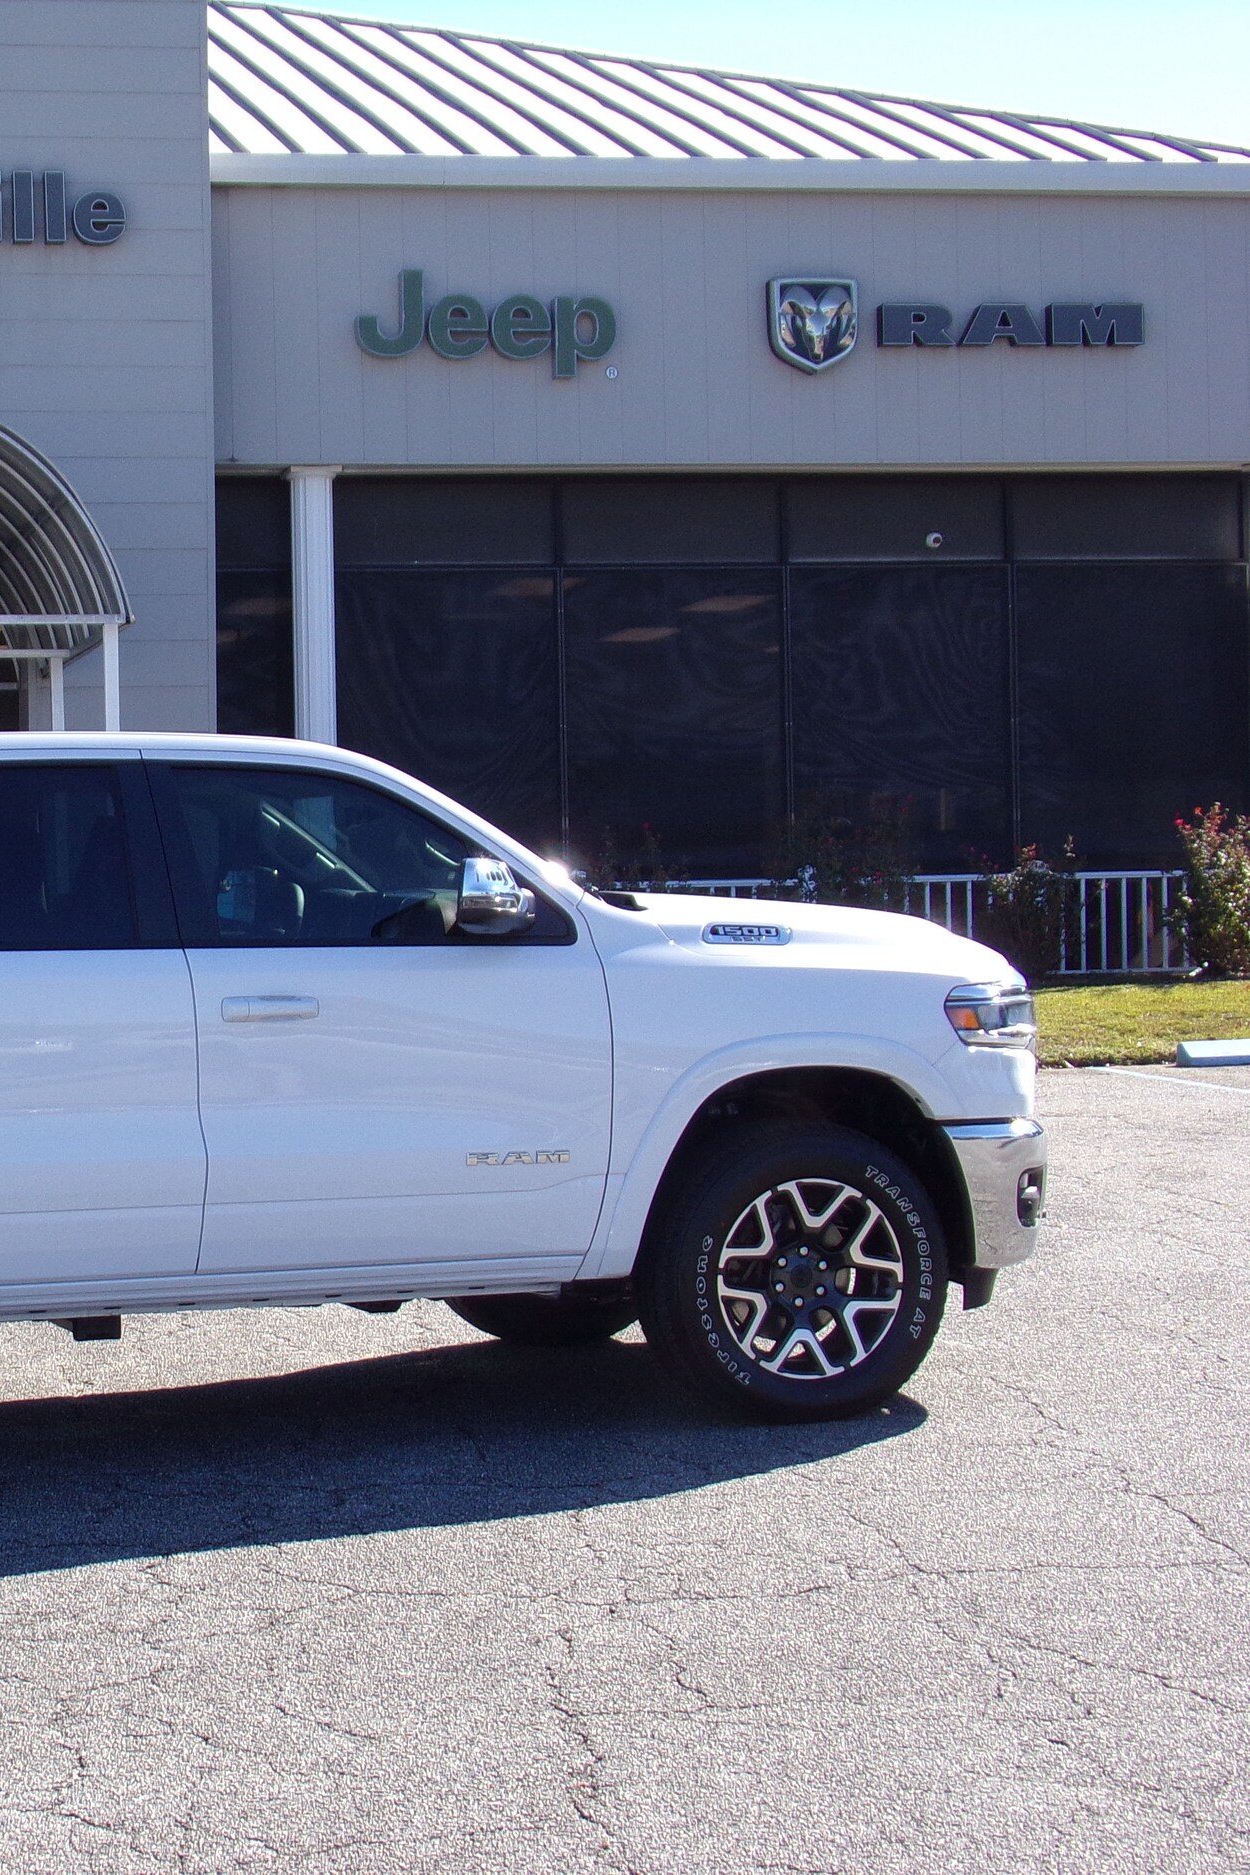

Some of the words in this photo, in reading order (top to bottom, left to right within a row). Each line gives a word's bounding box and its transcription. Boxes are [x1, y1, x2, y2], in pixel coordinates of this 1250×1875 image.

[356, 269, 618, 379] Jeep
[877, 302, 1146, 347] RAM
[717, 925, 777, 937] 1500
[466, 1149, 571, 1167] RAM
[865, 1165, 933, 1300] TRANSFORCE
[909, 1306, 926, 1339] AT
